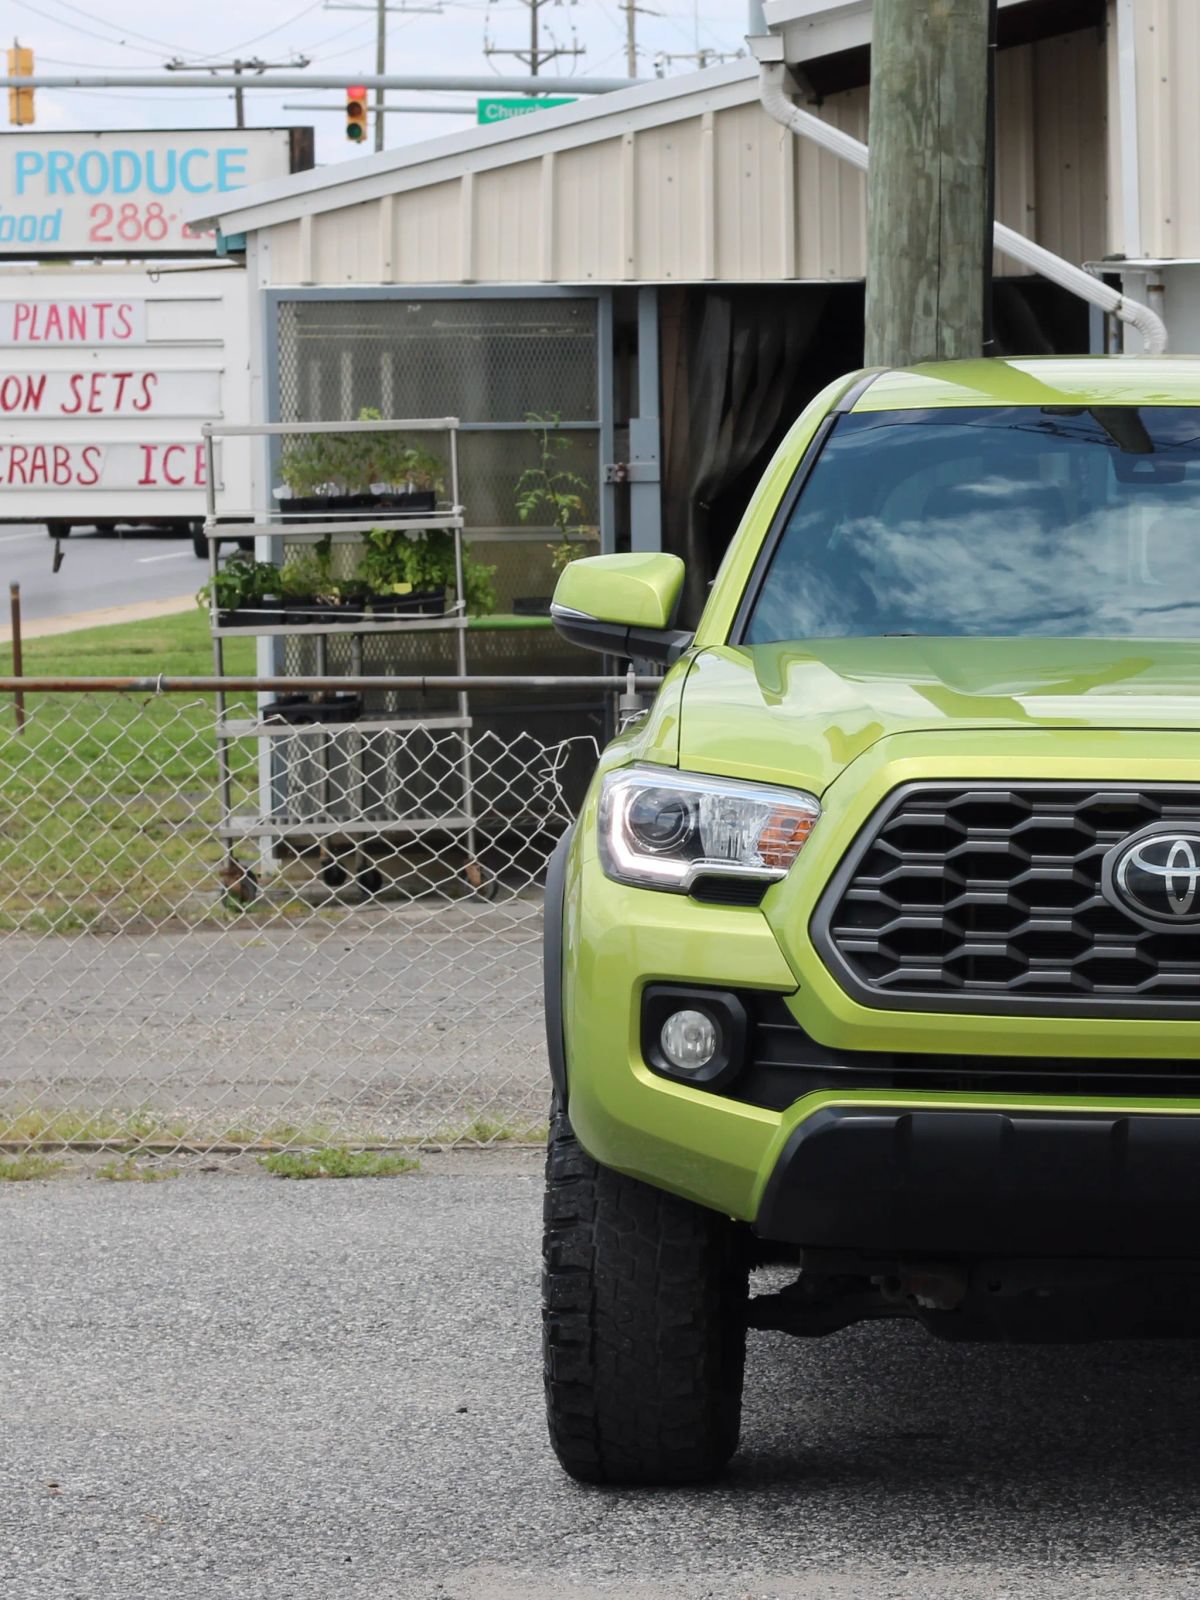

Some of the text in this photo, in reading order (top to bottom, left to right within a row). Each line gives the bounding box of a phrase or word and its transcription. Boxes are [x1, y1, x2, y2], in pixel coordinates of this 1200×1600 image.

[14, 147, 248, 195] PRODUCE
[12, 302, 133, 341] PLANTS
[0, 372, 158, 414] ON SETS
[0, 444, 207, 485] RABS ICE
